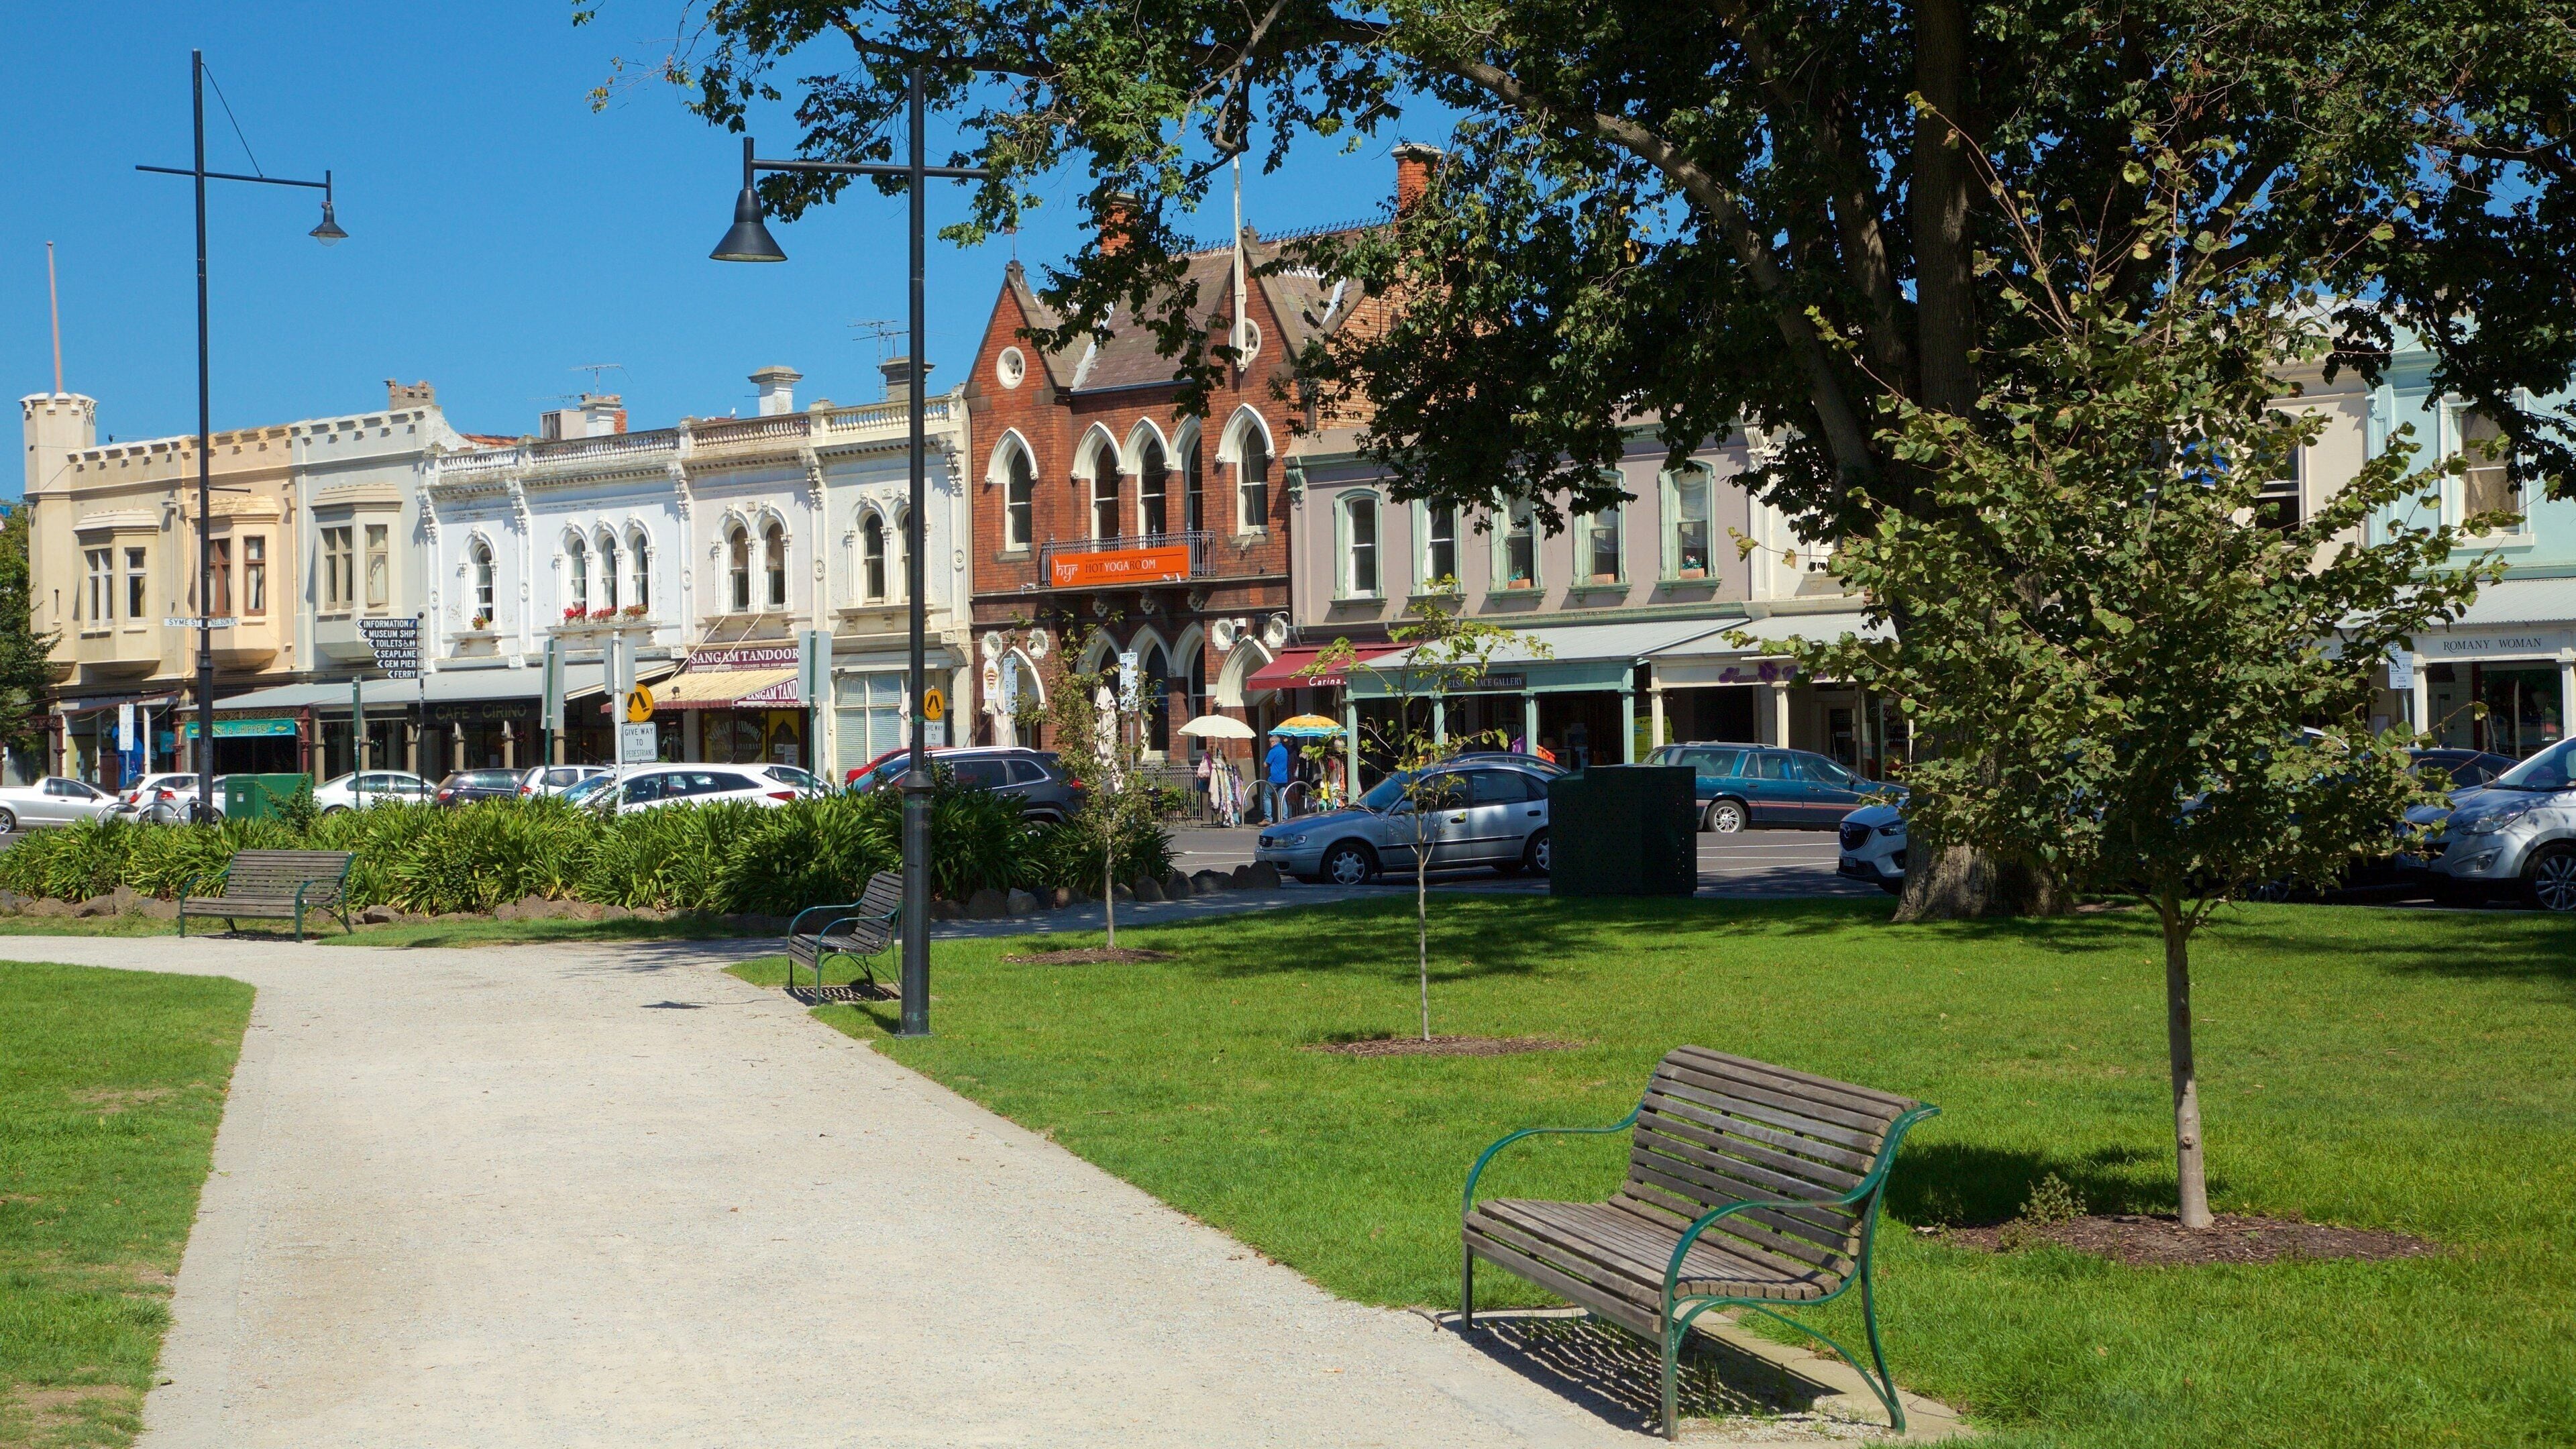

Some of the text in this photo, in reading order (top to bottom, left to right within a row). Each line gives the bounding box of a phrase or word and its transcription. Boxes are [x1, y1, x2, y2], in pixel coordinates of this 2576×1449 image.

[211, 618, 229, 626] NELSON
[364, 620, 409, 628] INFORMATION
[368, 629, 416, 637] MUSEUM SHIP
[376, 639, 402, 647] TOILETS
[2443, 638, 2541, 653] ROMANY WOMAN
[691, 648, 799, 664] SANGAM TANDOOR
[400, 660, 416, 668] PIER
[1309, 676, 1340, 686] Carina
[1476, 678, 1492, 687] LACE
[1494, 677, 1523, 686] GALLERY
[746, 679, 798, 700] SANGAM TAND
[436, 704, 527, 720] CAFE CIRINO
[641, 727, 653, 735] WAY
[626, 749, 655, 758] PEDESTRIANS
